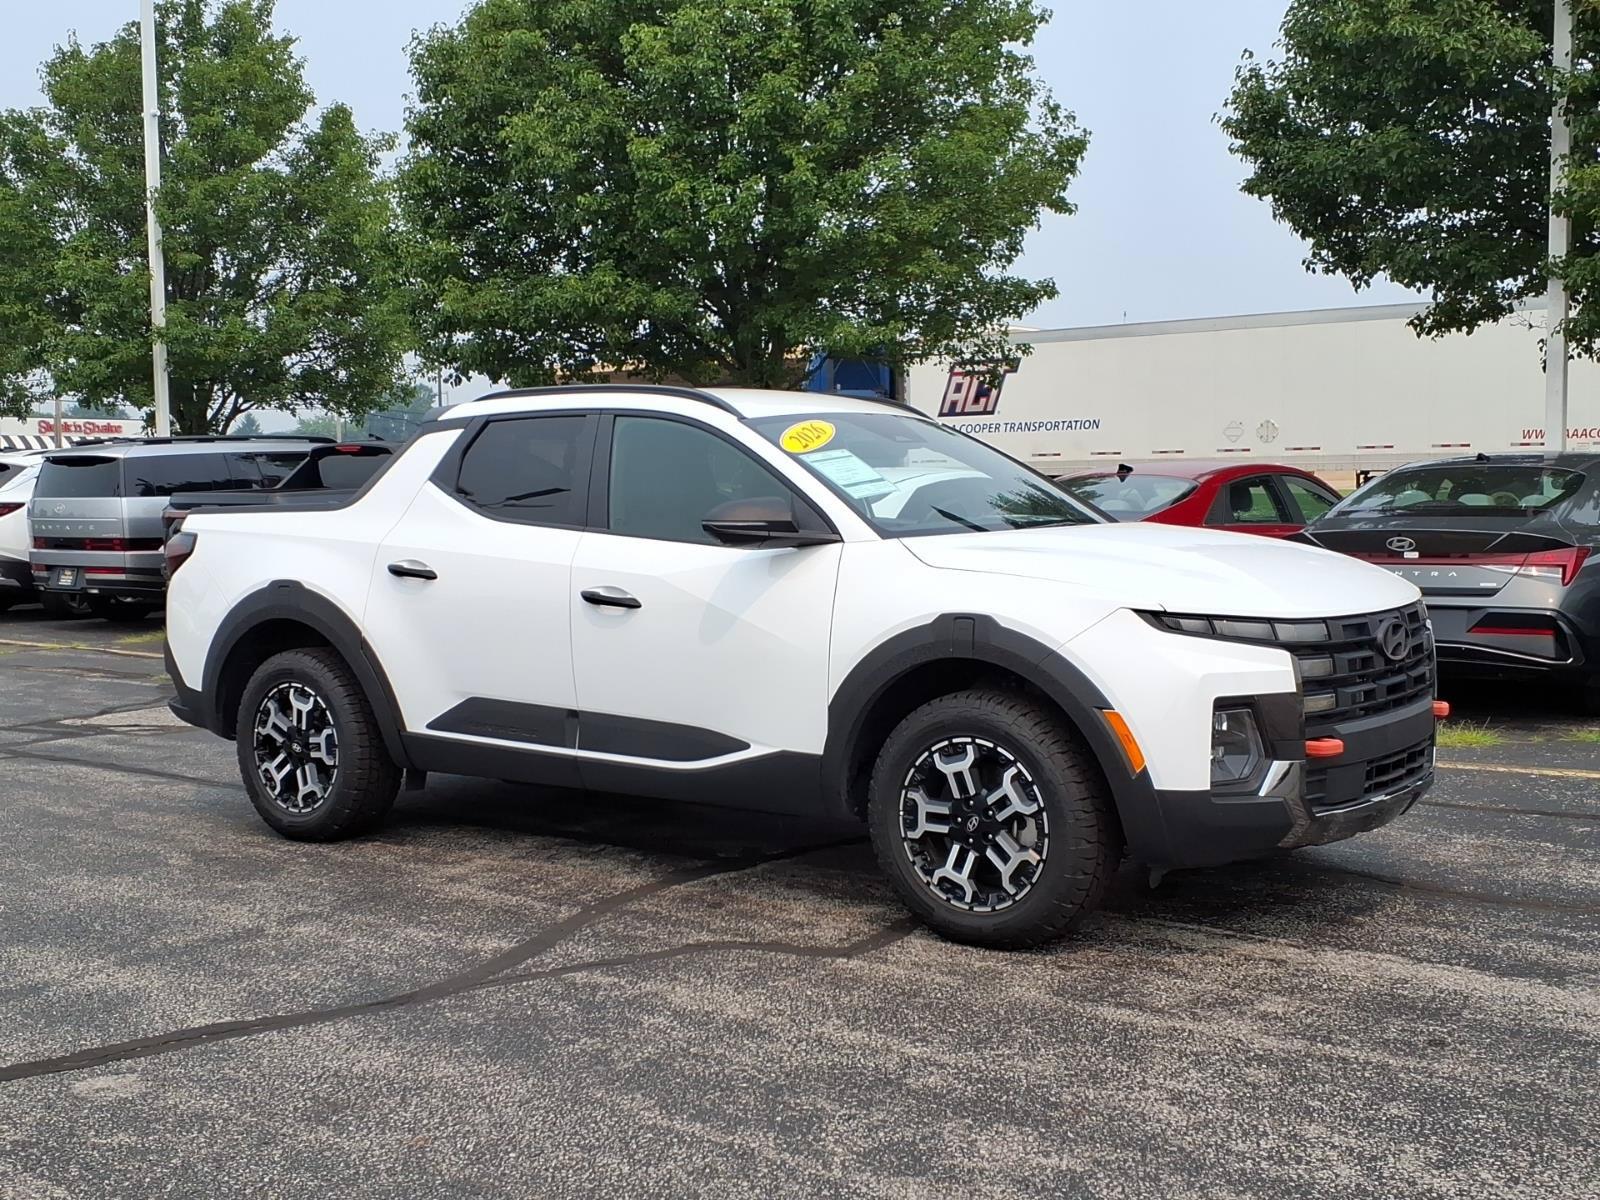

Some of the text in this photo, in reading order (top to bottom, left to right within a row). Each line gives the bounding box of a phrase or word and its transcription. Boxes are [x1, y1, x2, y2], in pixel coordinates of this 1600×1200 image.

[83, 421, 122, 435] Shake
[959, 422, 1000, 434] COOPER
[1004, 419, 1101, 433] TRANSPORTATION
[788, 423, 828, 449] 2026
